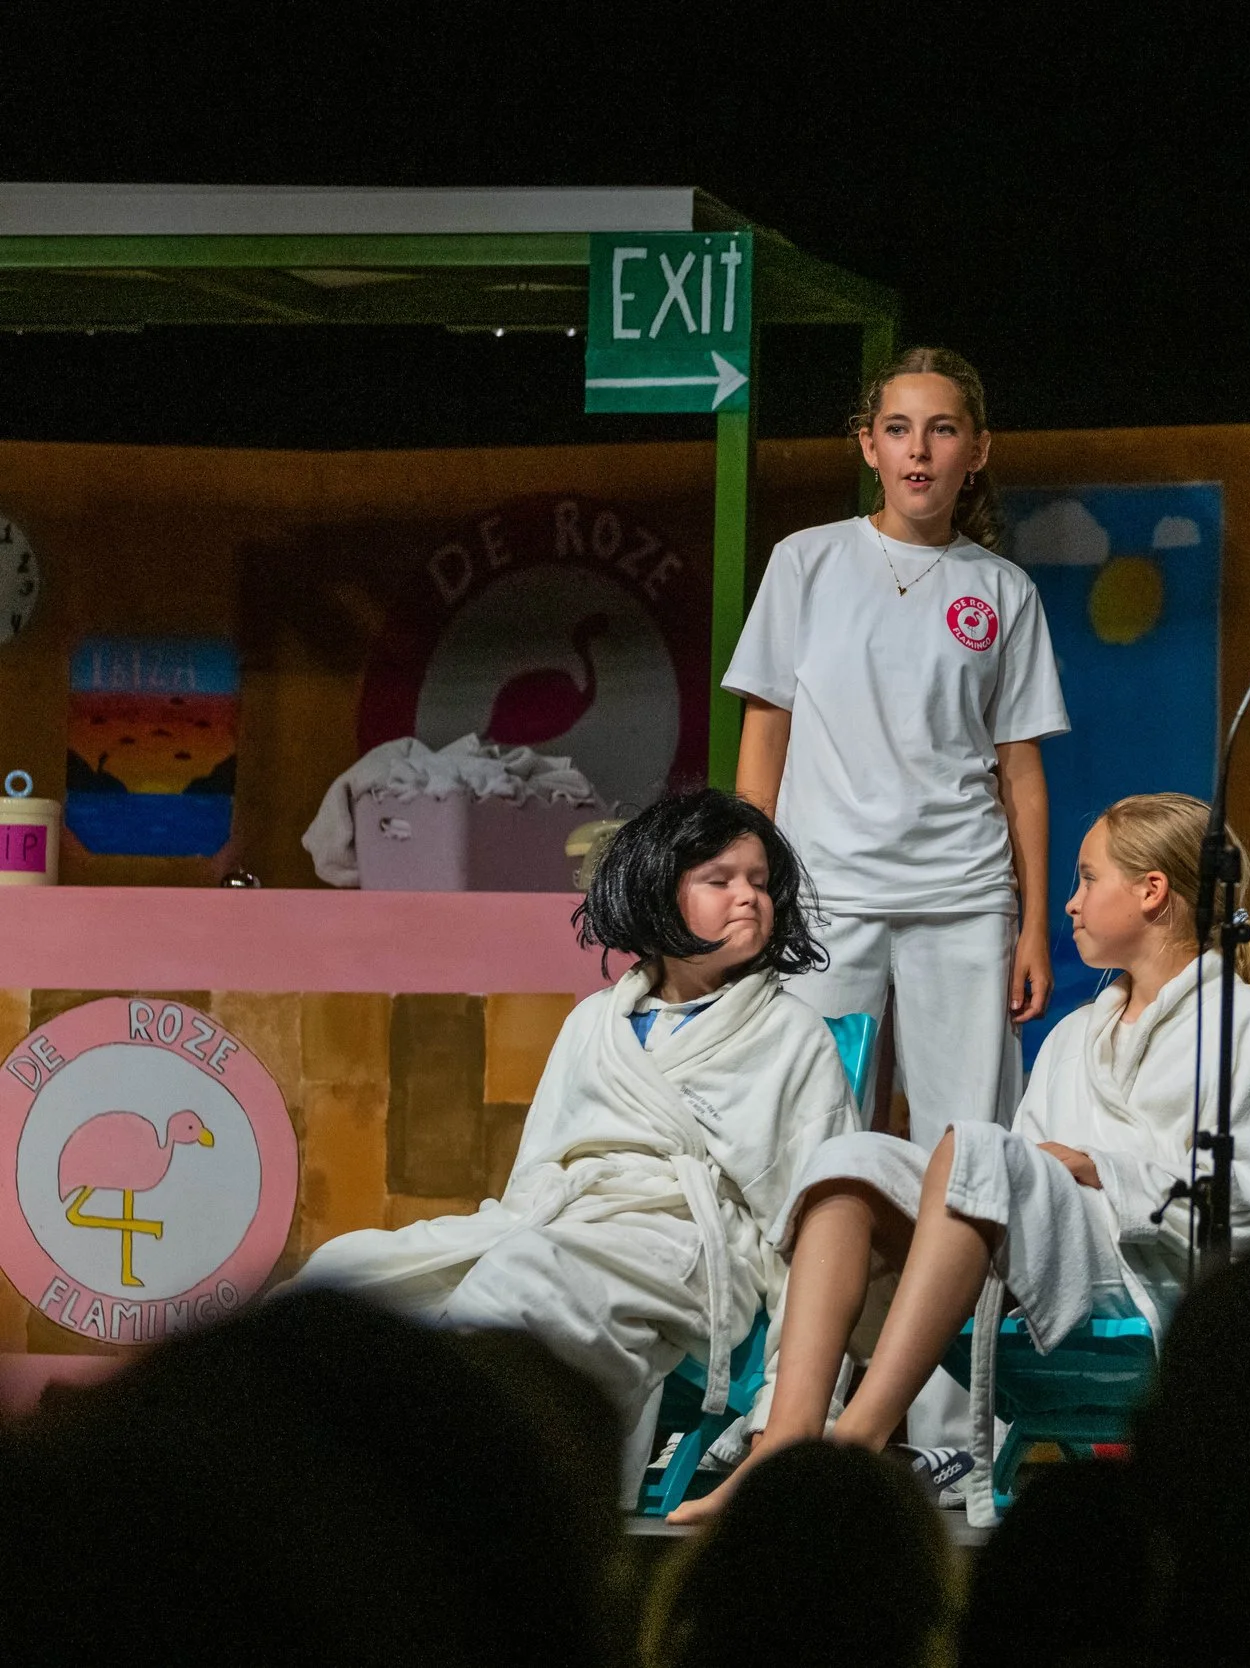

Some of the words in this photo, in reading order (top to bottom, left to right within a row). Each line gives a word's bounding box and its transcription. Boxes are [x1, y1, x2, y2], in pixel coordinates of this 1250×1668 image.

[612, 237, 743, 340] EXit
[427, 514, 513, 602] DE
[554, 499, 683, 602] ROZE
[952, 627, 991, 650] FLAMINGO
[953, 599, 967, 611] DE
[969, 599, 995, 620] ROZE
[6, 1035, 65, 1093] DE
[128, 1000, 239, 1075] ROZE
[38, 1275, 241, 1342] FLAMINGO
[933, 1461, 963, 1485] adidas
